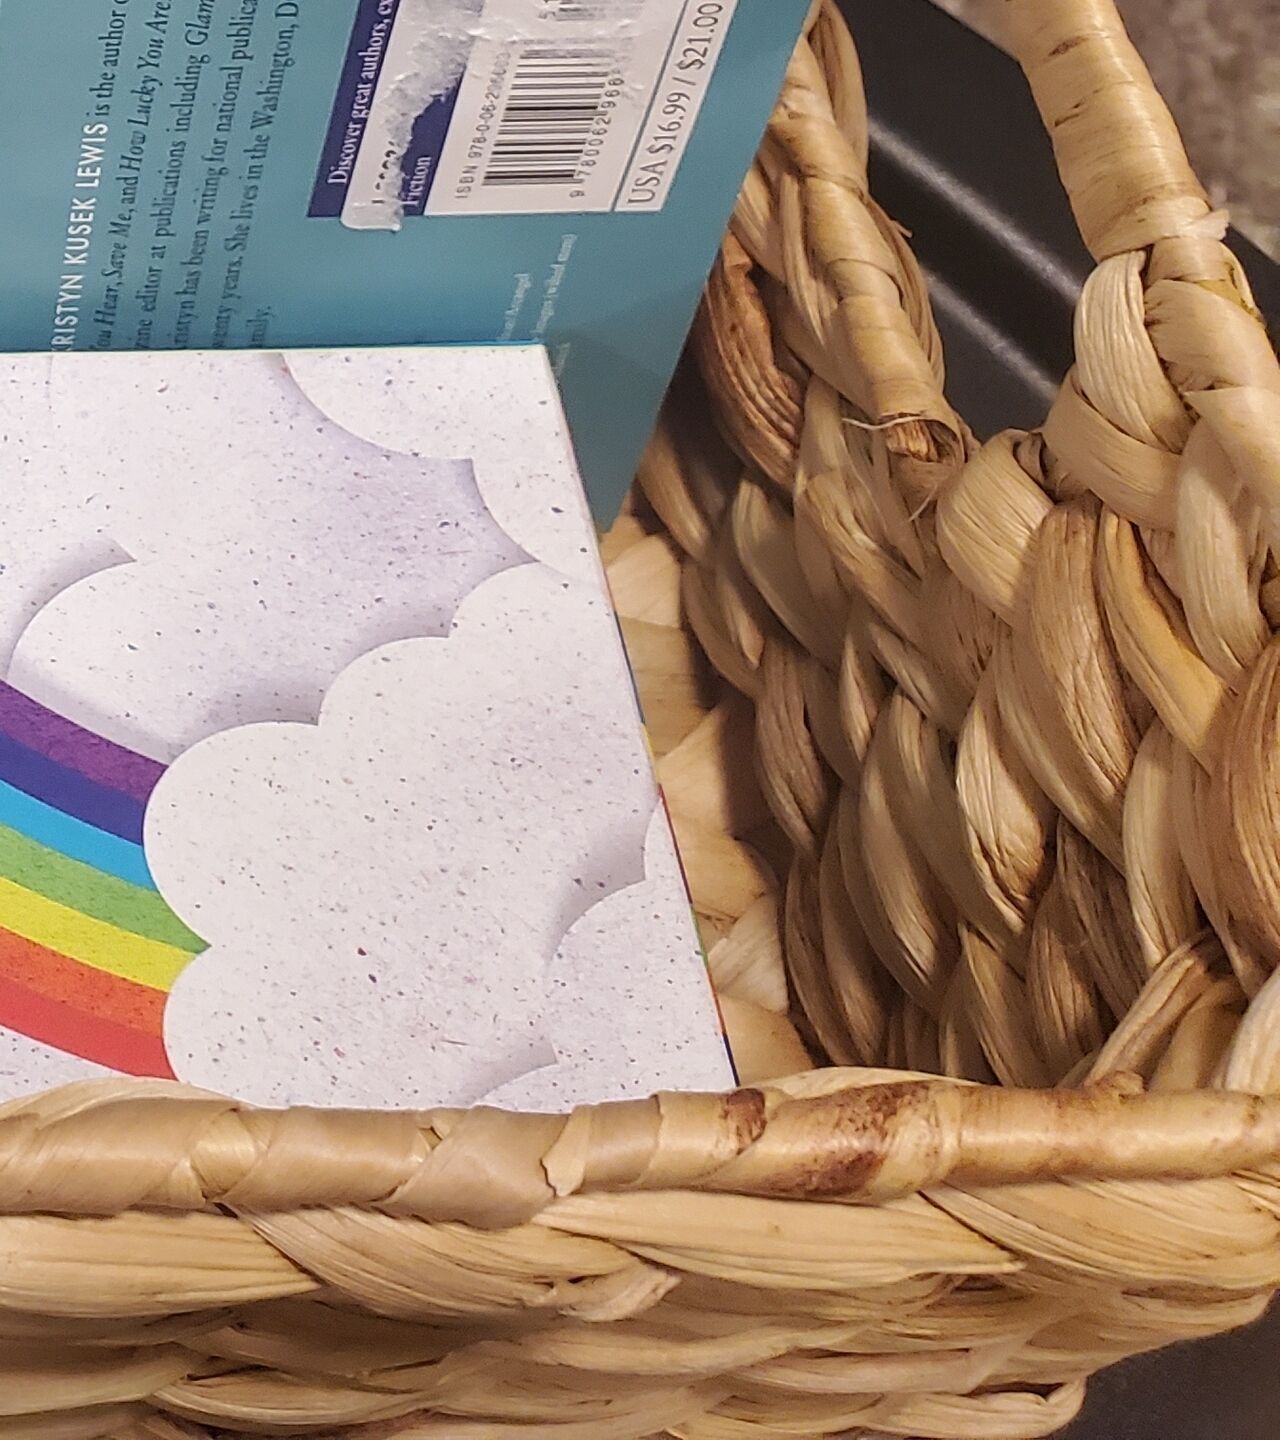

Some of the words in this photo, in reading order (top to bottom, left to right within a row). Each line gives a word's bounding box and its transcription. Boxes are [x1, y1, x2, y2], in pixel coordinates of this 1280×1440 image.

[96, 9, 126, 67] author
[357, 16, 391, 75] authors,
[676, 2, 724, 71] $21.00
[85, 103, 111, 117] is
[88, 71, 116, 98] the
[351, 74, 371, 120] great
[327, 112, 362, 186] Discover
[646, 91, 691, 156] $16.99
[73, 121, 110, 188] LEWIS
[455, 164, 479, 199] ISBN
[627, 160, 669, 204] USA
[62, 197, 97, 264] KUSEK
